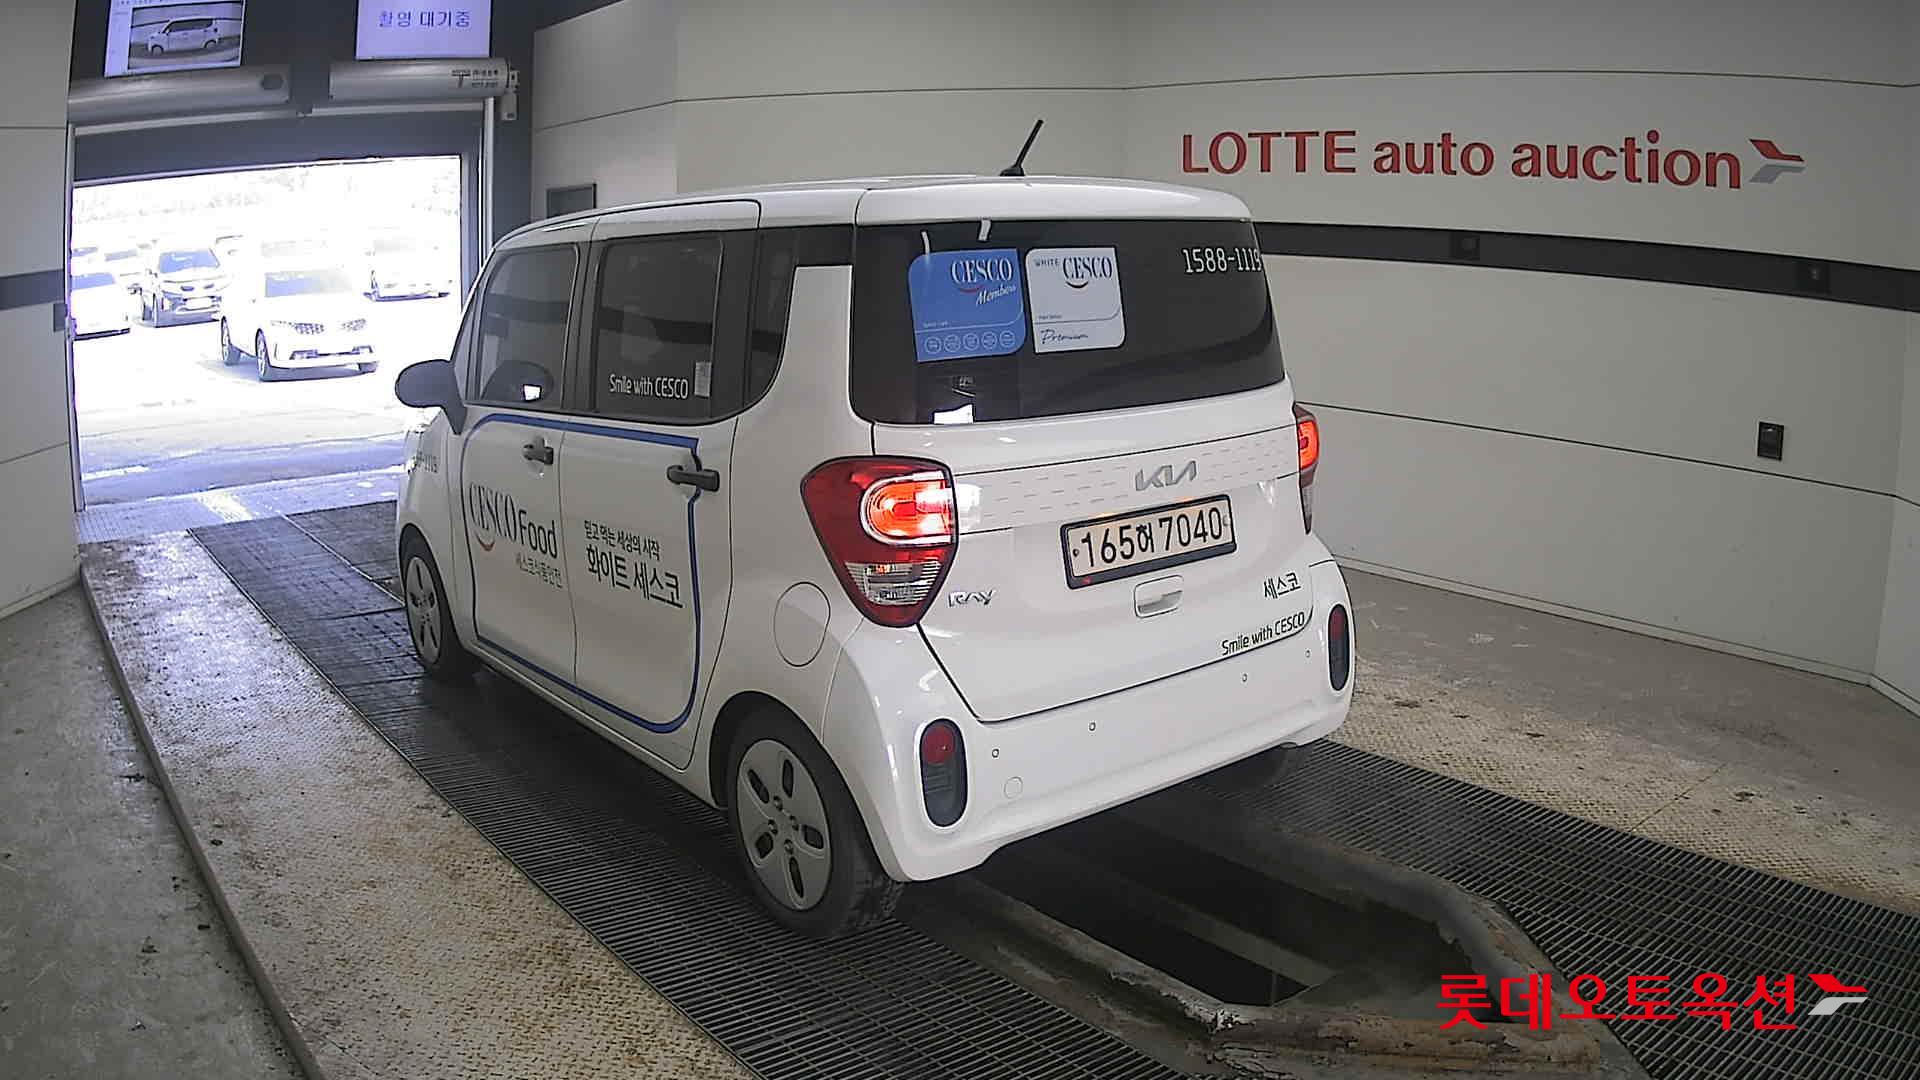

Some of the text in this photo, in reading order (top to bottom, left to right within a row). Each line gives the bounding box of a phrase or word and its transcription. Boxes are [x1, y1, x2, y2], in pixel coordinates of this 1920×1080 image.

[419, 11, 471, 28] 대기중
[1182, 130, 1741, 189] LOTTE auto auction
[951, 258, 1013, 284] CESCO
[1034, 256, 1113, 280] WHITE CESCO
[1182, 247, 1262, 273] 1588-1119
[609, 373, 689, 399] Smile with CESCO
[1135, 460, 1197, 492] KIA
[469, 482, 558, 559] CESCO Food
[1158, 506, 1222, 551] 7040
[586, 543, 683, 608] 화이트 세스코
[1263, 571, 1302, 600] 세스코
[1221, 611, 1305, 656] Smile with CESCO
